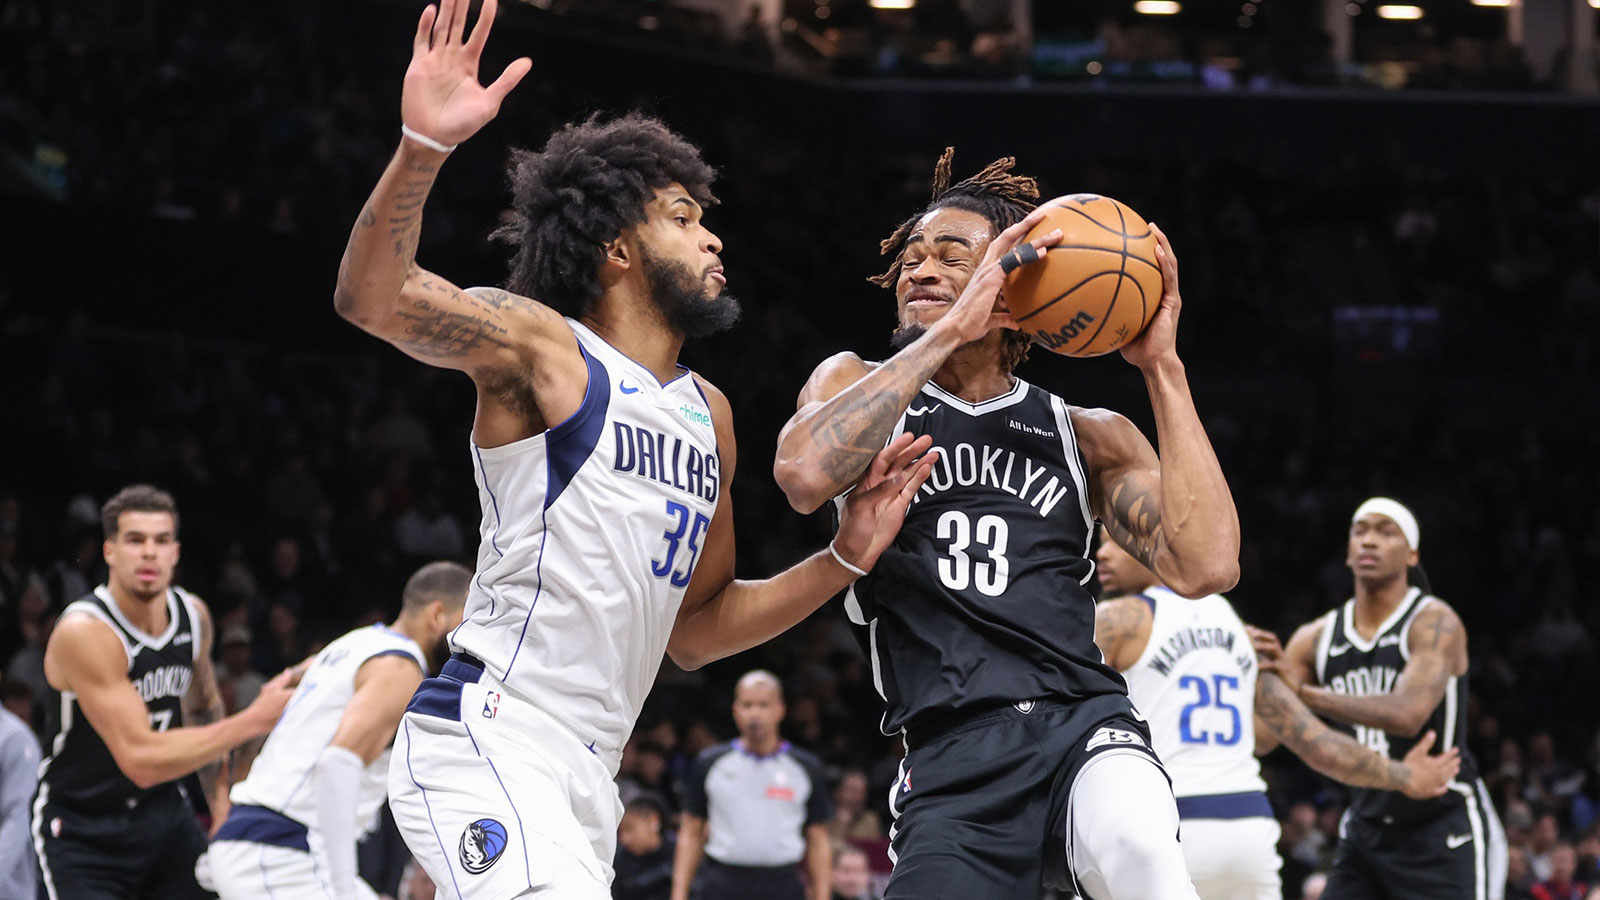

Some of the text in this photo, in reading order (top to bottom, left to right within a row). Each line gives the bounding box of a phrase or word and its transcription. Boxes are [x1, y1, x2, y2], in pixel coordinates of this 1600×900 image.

[612, 420, 718, 504] DALLAS
[1009, 419, 1055, 438] All In Won
[651, 499, 710, 588] 35
[936, 510, 1009, 597] 33
[1147, 627, 1235, 677] WASHINGTON
[1178, 674, 1242, 746] 25
